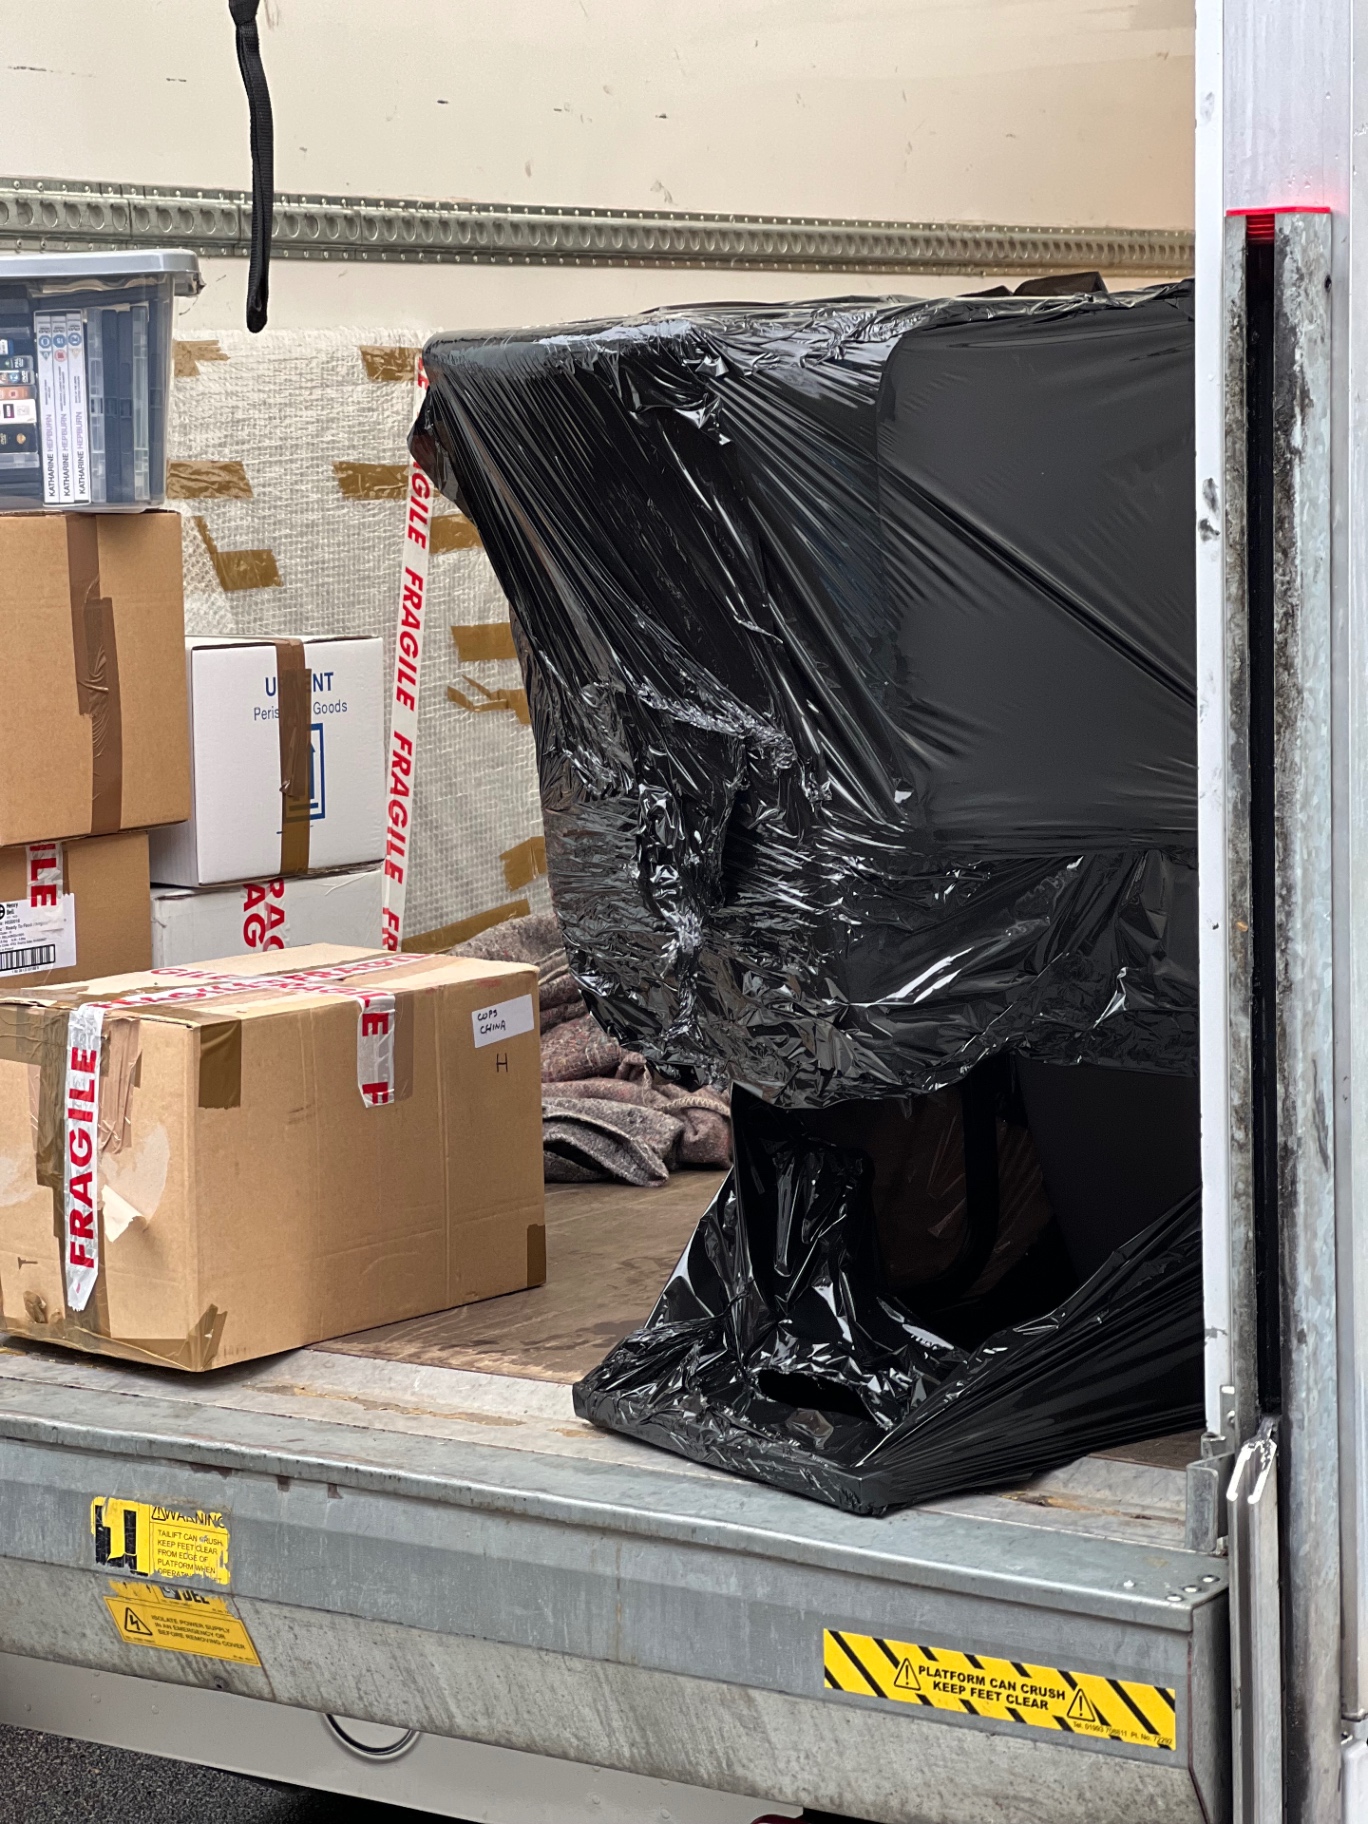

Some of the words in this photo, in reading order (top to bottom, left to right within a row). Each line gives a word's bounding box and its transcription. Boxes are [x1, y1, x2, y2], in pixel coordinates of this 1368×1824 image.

[46, 414, 54, 452] HEPBURN
[60, 413, 68, 452] HEPBURN
[76, 412, 84, 450] HEPBURN
[47, 454, 56, 497] KATHARINE
[62, 452, 70, 497] KATHARINE
[77, 450, 86, 495] KATHARINE
[407, 462, 430, 550] GILE
[396, 566, 423, 712] FRAGILE
[265, 672, 334, 697] UNT
[313, 699, 348, 715] Goods
[385, 730, 413, 884] FRAGILE
[480, 1020, 506, 1034] CHINA
[496, 1052, 508, 1072] H
[68, 1047, 97, 1268] FRAGILE
[158, 1530, 182, 1538] TAILIFT
[184, 1534, 198, 1542] CAN
[158, 1540, 176, 1548] KEEP
[178, 1542, 194, 1551] FEET
[196, 1546, 218, 1554] CLEAR
[158, 1548, 178, 1558] FROM
[178, 1552, 198, 1561] EDGE
[158, 1558, 194, 1570] PLATFORM
[194, 1564, 216, 1574] WHEN
[158, 1628, 184, 1638] BEFORE
[222, 1640, 246, 1650] COVER
[179, 1619, 204, 1628] POWER
[205, 1624, 230, 1634] SUPPLY
[918, 1665, 986, 1686] PLATFORM
[989, 1678, 1016, 1692] CAN
[1020, 1683, 1066, 1700] CRUSH
[933, 1680, 966, 1695] KEEP
[970, 1688, 1002, 1702] FEET
[1006, 1694, 1049, 1710] CLEAR
